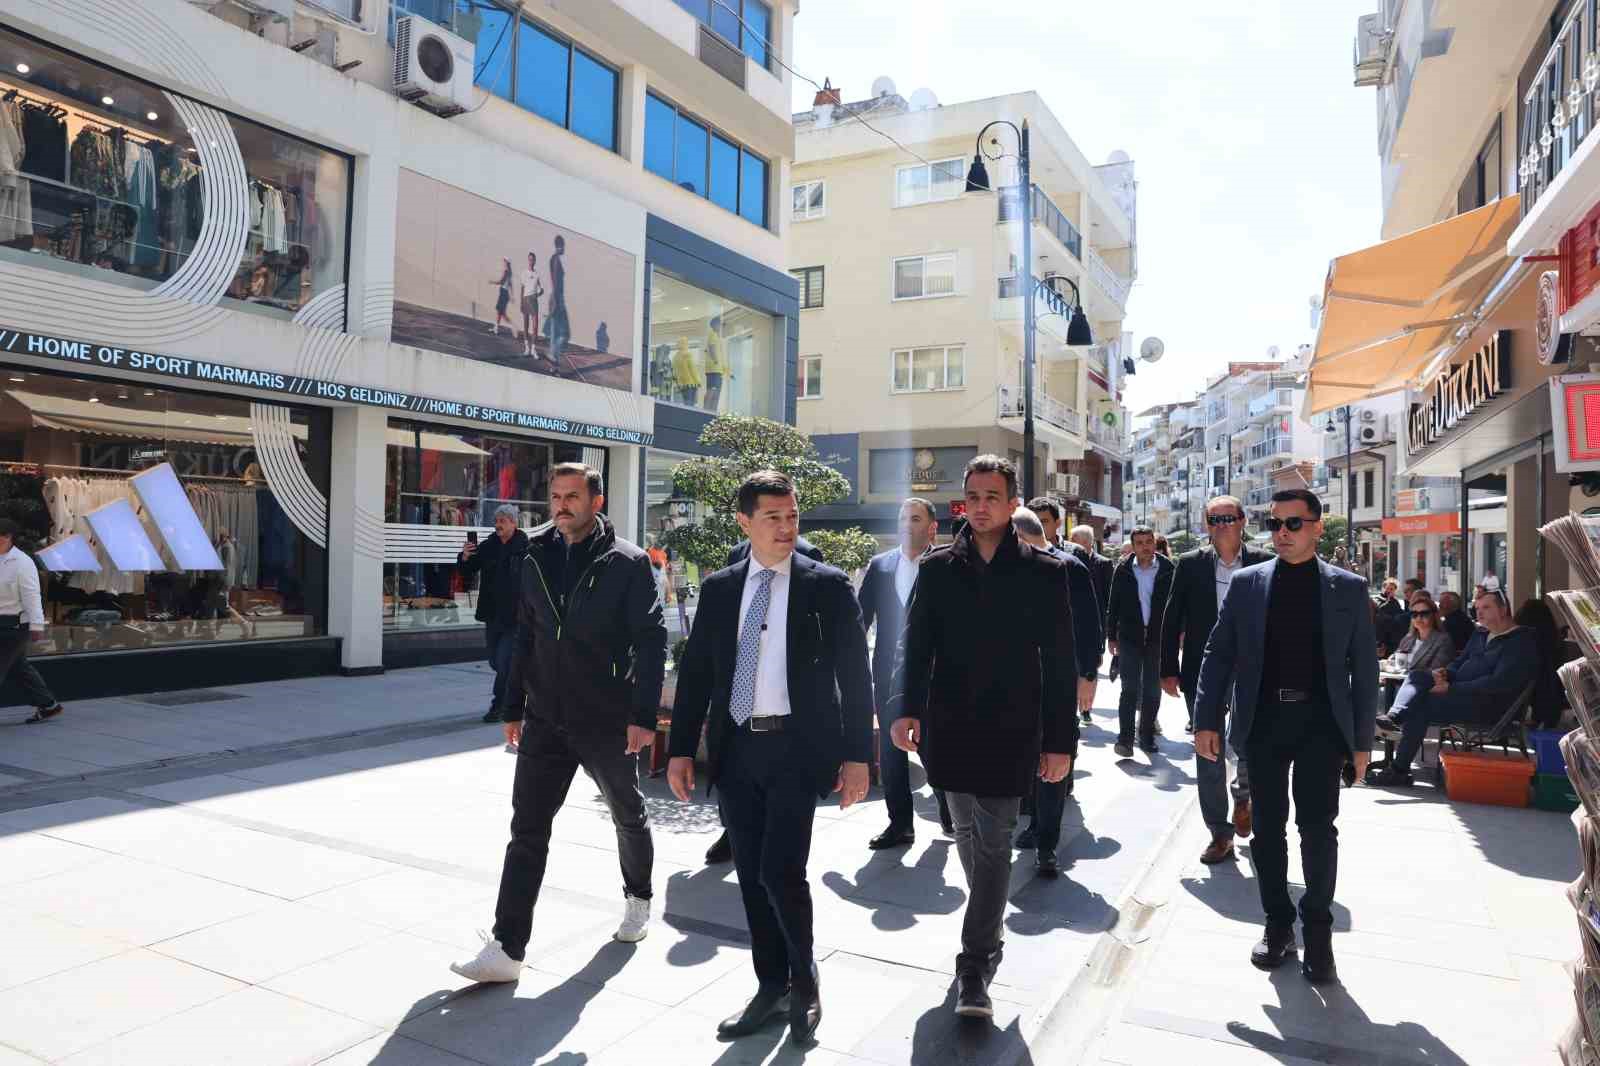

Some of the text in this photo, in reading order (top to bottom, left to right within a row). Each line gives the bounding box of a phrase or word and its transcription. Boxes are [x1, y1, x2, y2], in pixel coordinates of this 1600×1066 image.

[27, 335, 92, 360] HOME
[98, 347, 125, 365] OF
[129, 352, 192, 375] SPORT
[317, 382, 347, 399] HOŞ
[465, 405, 480, 418] OF
[481, 408, 515, 423] SPORT
